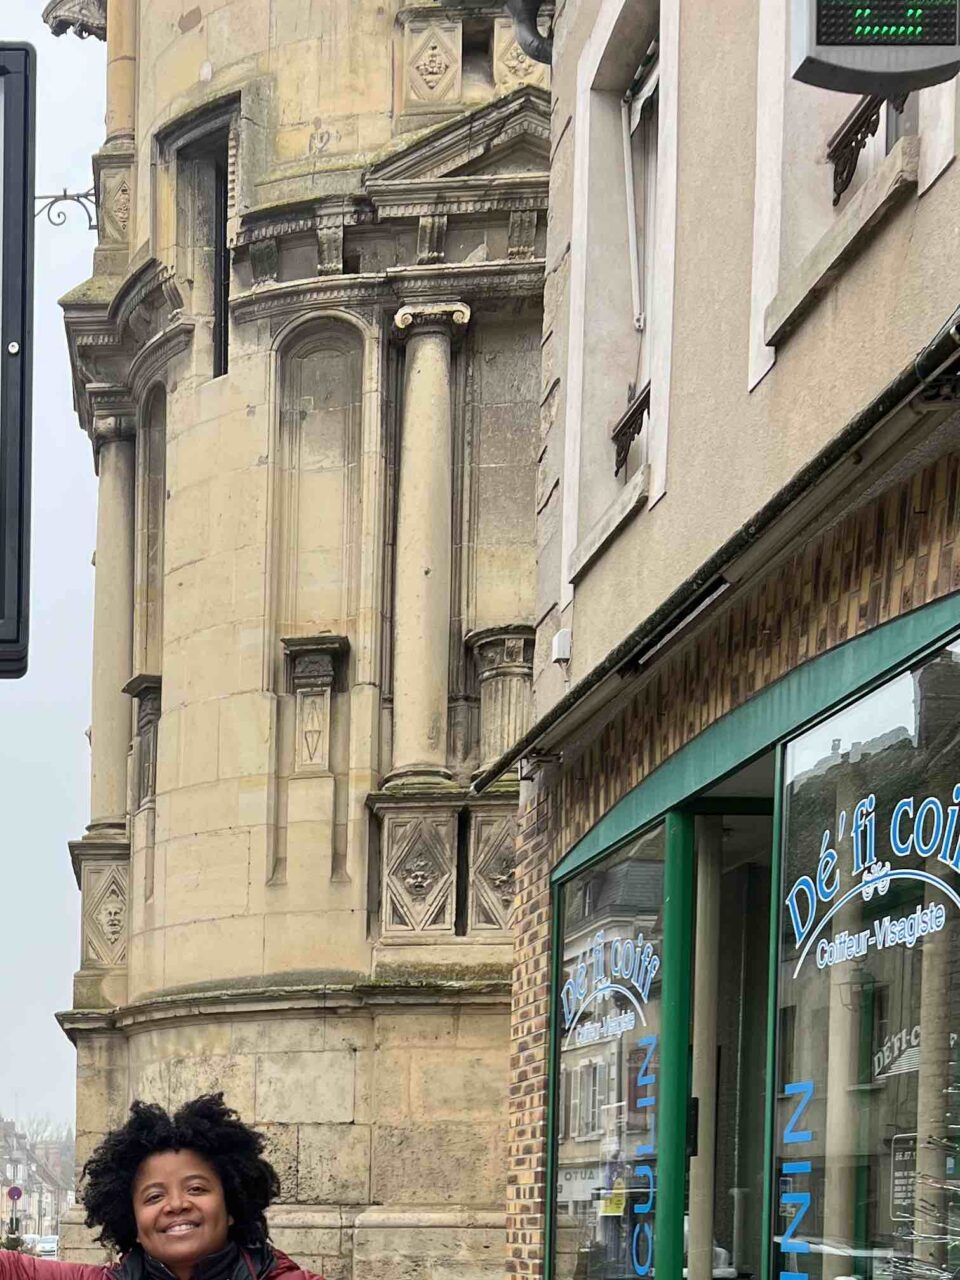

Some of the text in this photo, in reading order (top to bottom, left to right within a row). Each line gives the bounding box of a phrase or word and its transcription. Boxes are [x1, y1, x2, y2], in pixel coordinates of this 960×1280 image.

[890, 783, 960, 876] coi
[610, 933, 660, 1004] coiff
[816, 902, 946, 969] Coiffeur-Visagiste
